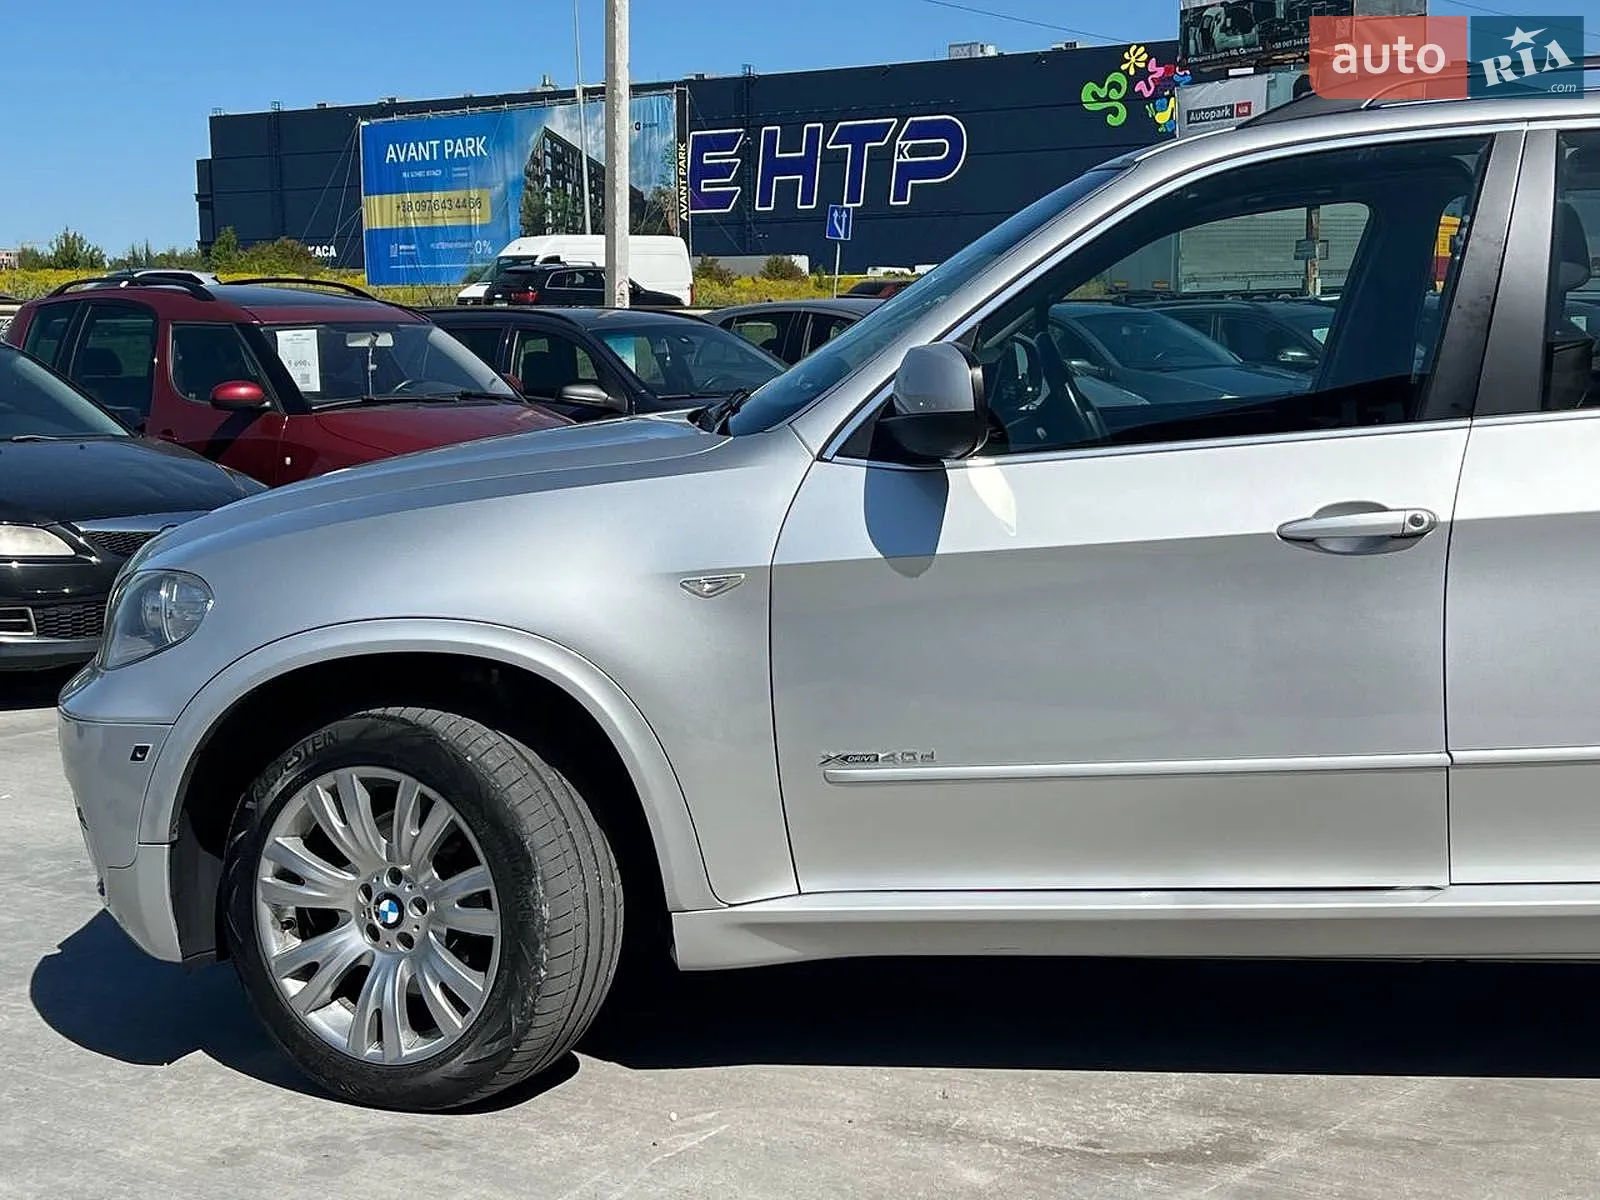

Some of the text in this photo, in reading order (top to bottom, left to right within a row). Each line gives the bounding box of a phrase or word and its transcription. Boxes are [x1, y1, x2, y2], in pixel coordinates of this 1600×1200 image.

[1189, 106, 1232, 121] Autopark
[385, 136, 488, 163] AVANT PARK
[678, 143, 688, 221] AVANT PARK
